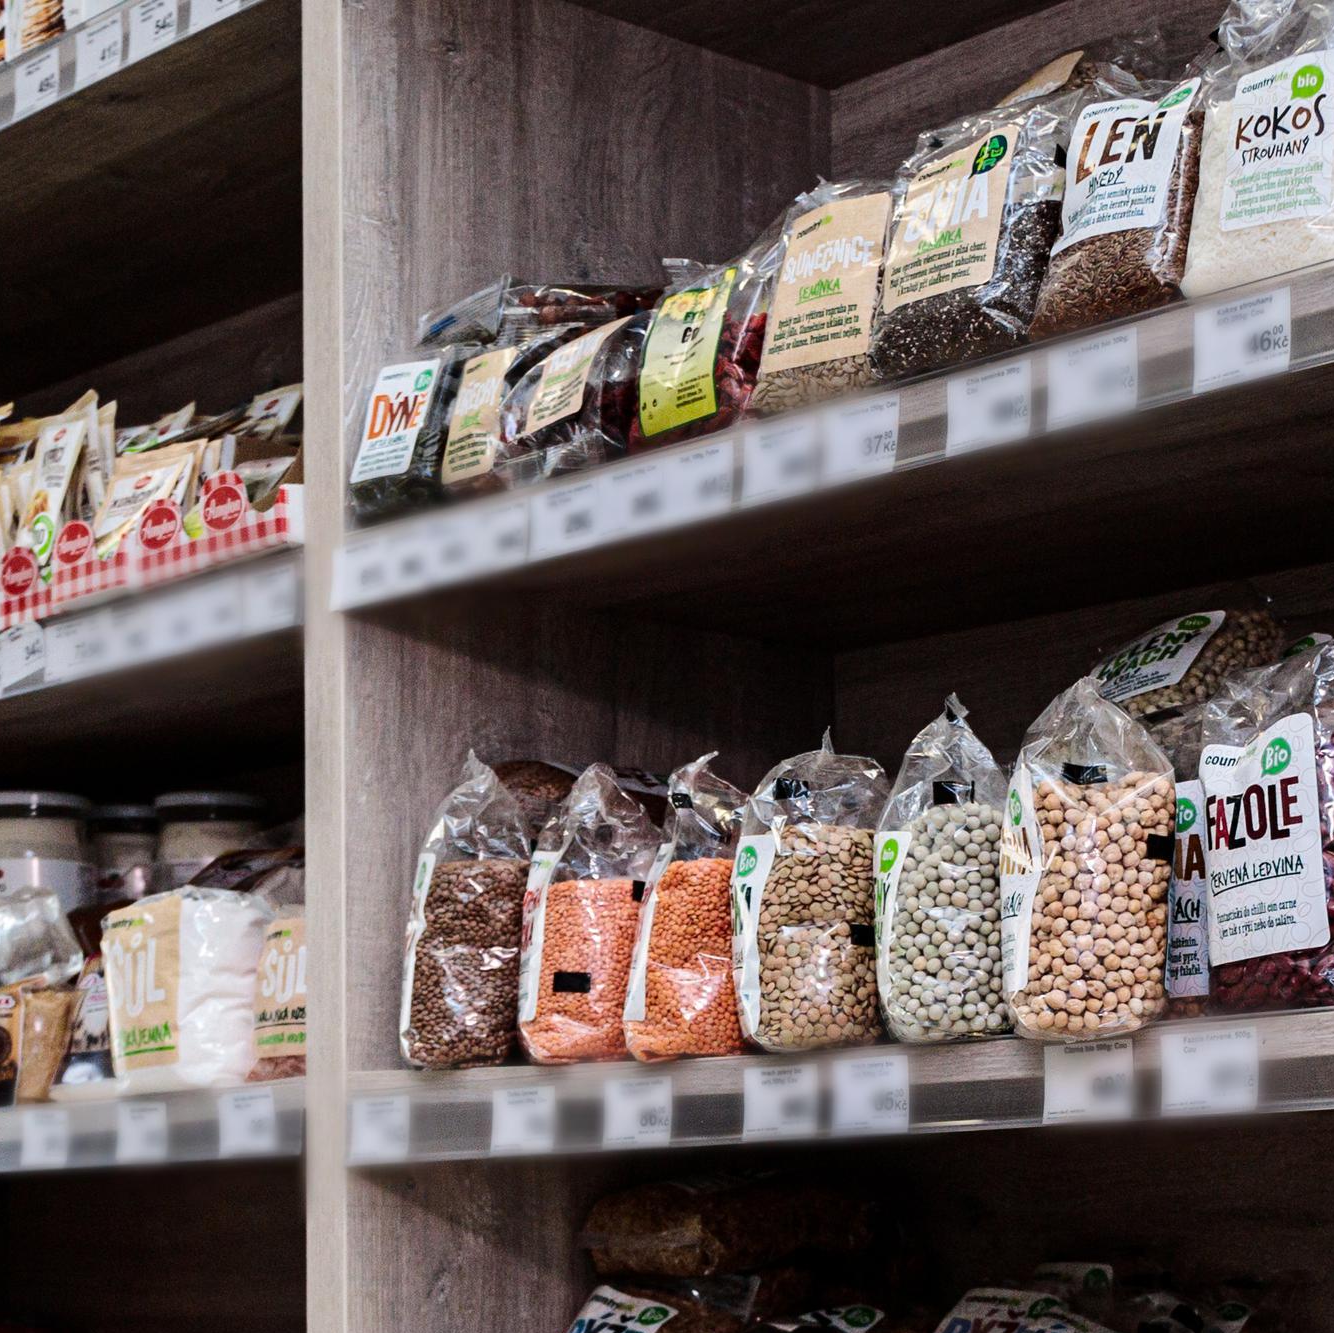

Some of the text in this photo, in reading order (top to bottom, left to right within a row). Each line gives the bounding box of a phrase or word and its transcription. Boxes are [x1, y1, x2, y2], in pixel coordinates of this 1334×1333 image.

[1297, 76, 1317, 89] bio
[1235, 94, 1327, 150] KOKOS
[1075, 110, 1167, 185] LEN
[782, 235, 876, 284] SLUNEČNICE
[1273, 337, 1289, 350] Kč
[368, 386, 430, 441] DÝNĚ
[1265, 742, 1288, 768] Bio
[1206, 775, 1303, 851] FAZOLE
[1253, 855, 1304, 879] LEDVINA
